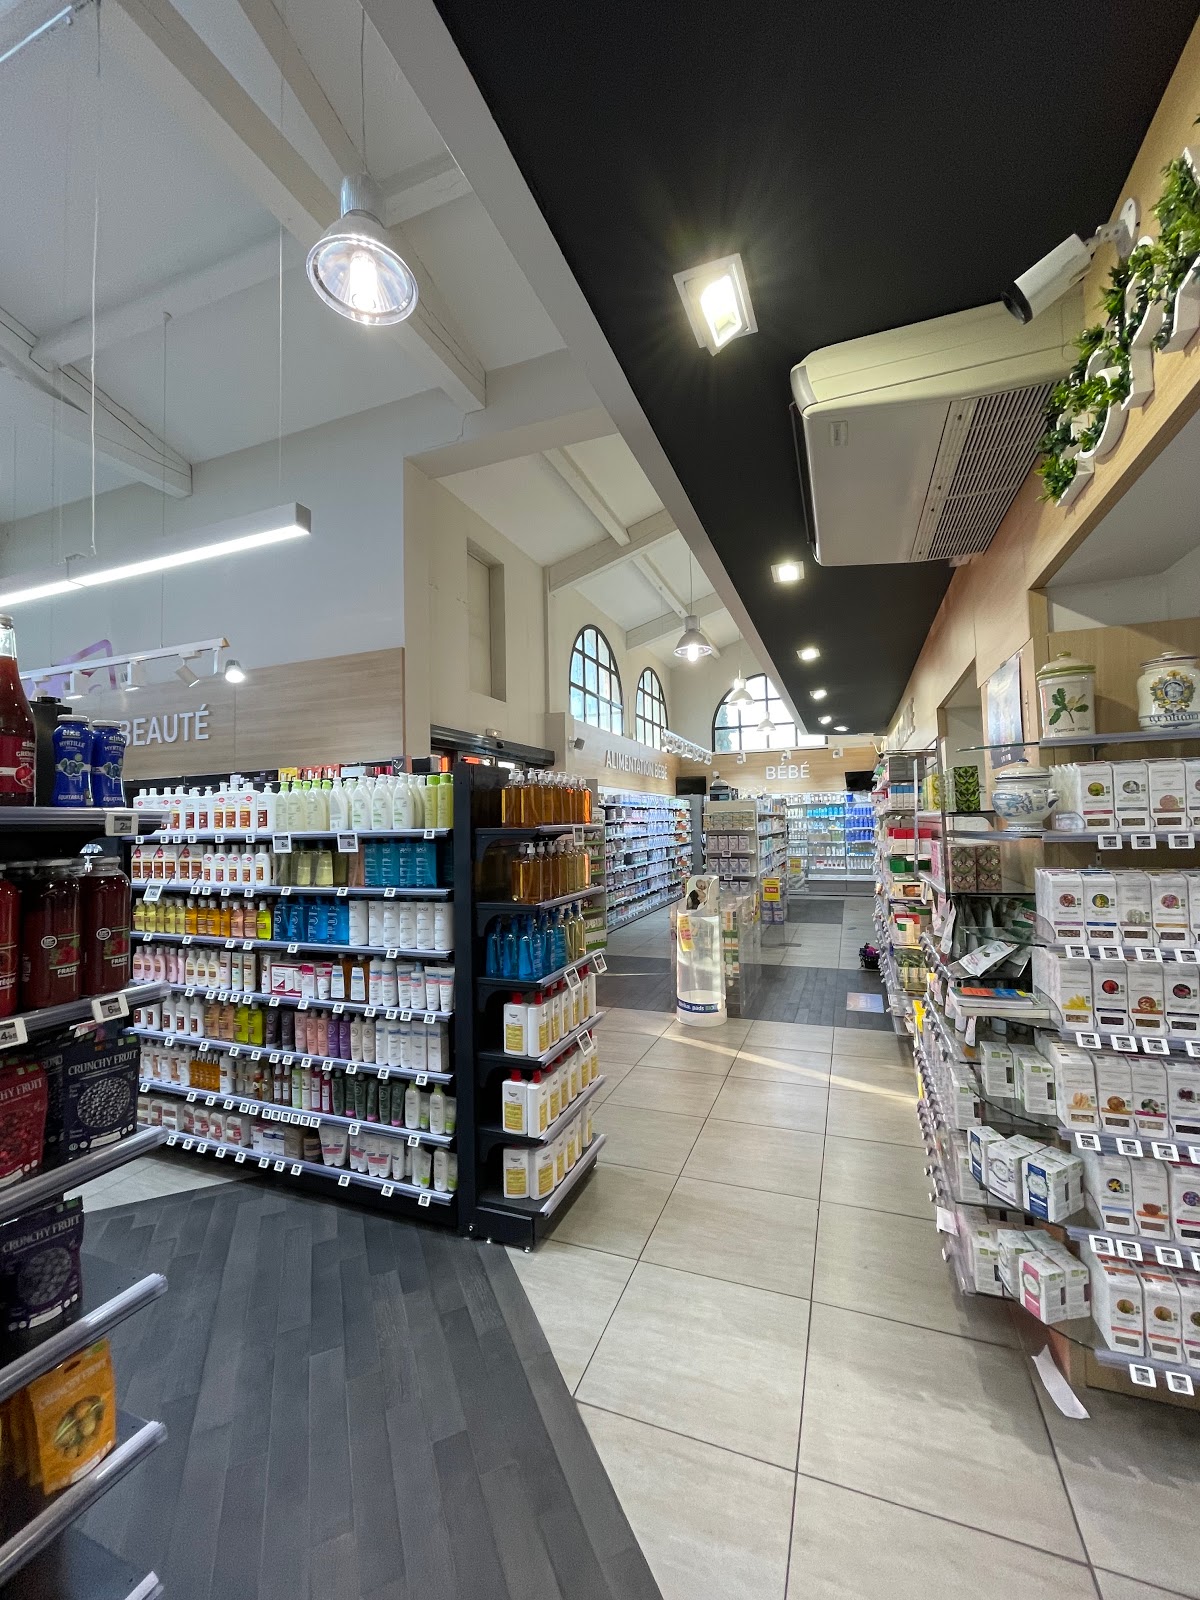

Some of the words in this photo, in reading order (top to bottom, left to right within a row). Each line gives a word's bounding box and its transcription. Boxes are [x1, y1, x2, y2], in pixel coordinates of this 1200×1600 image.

[119, 703, 209, 747] BEAUTÉ
[59, 740, 86, 749] MYRTILLE
[605, 750, 654, 778] ALIMENTATION
[654, 762, 668, 780] BÉBÉ
[765, 760, 811, 780] BÉBÉ
[68, 1056, 113, 1076] CRUNCHY
[113, 1049, 139, 1065] FRUIT
[16, 1077, 43, 1096] FRUIT
[2, 1225, 51, 1254] CRUNCHY
[52, 1214, 81, 1233] FRUIT
